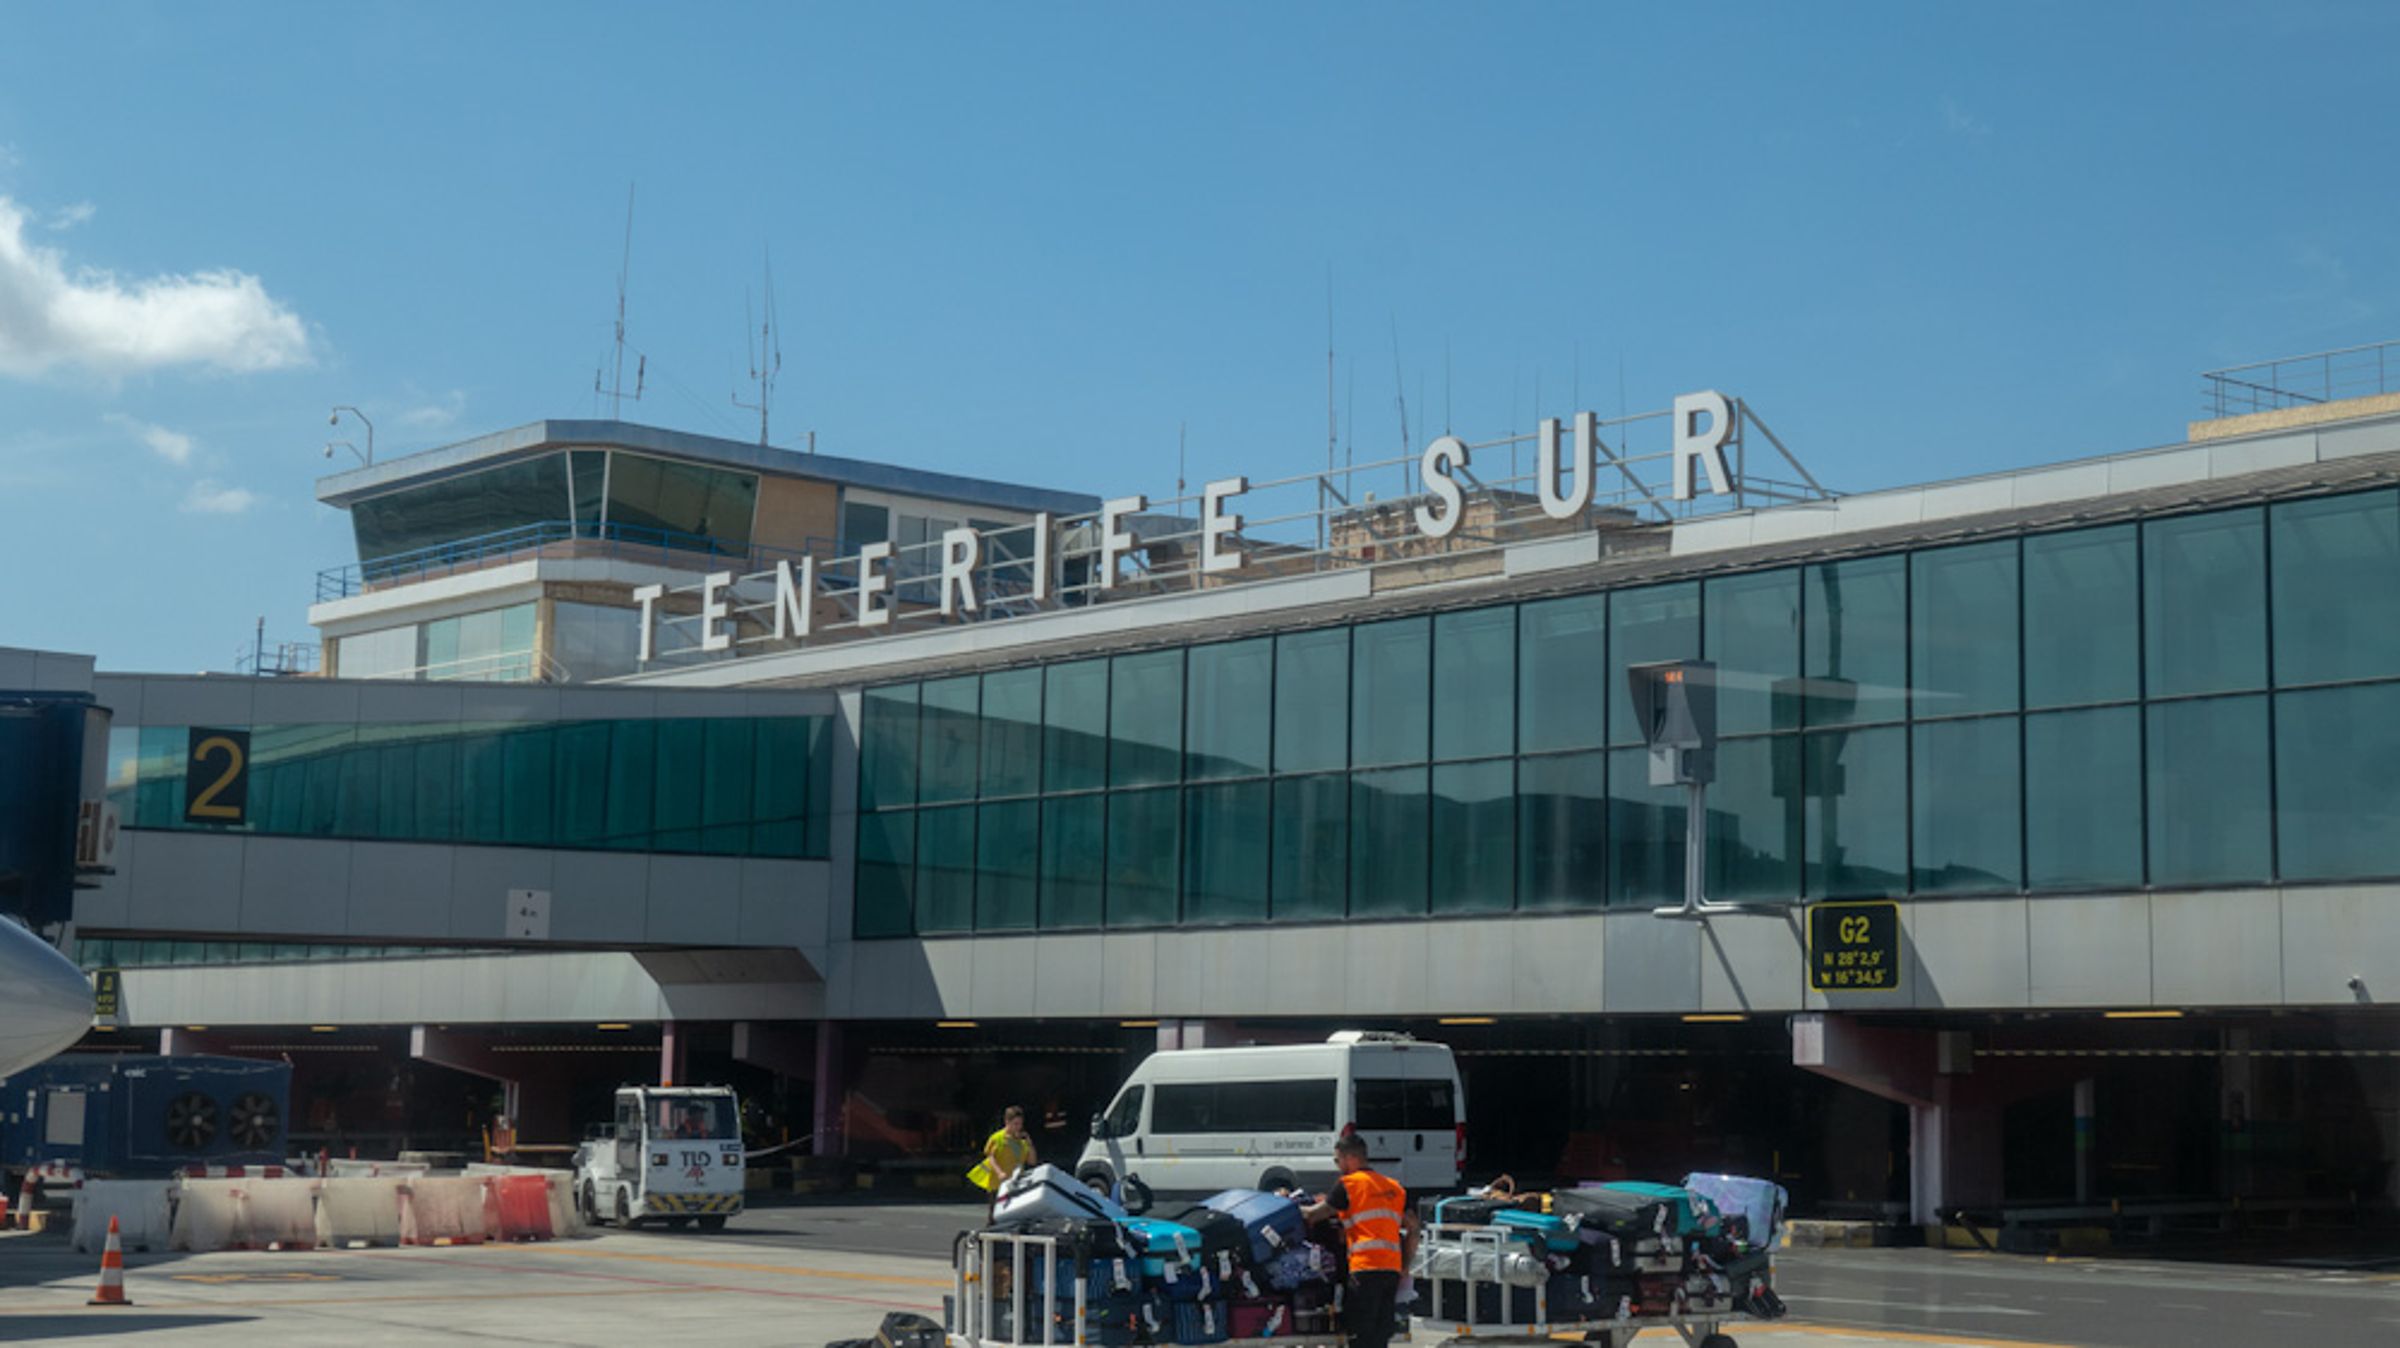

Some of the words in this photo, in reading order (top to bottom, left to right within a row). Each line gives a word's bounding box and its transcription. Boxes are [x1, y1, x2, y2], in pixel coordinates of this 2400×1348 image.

[633, 476, 1248, 662] TENERIFE
[1414, 389, 1736, 538] SUR
[191, 736, 243, 817] 2
[1840, 915, 1870, 944] G2
[1823, 951, 1834, 966] N
[1821, 971, 1832, 985] W
